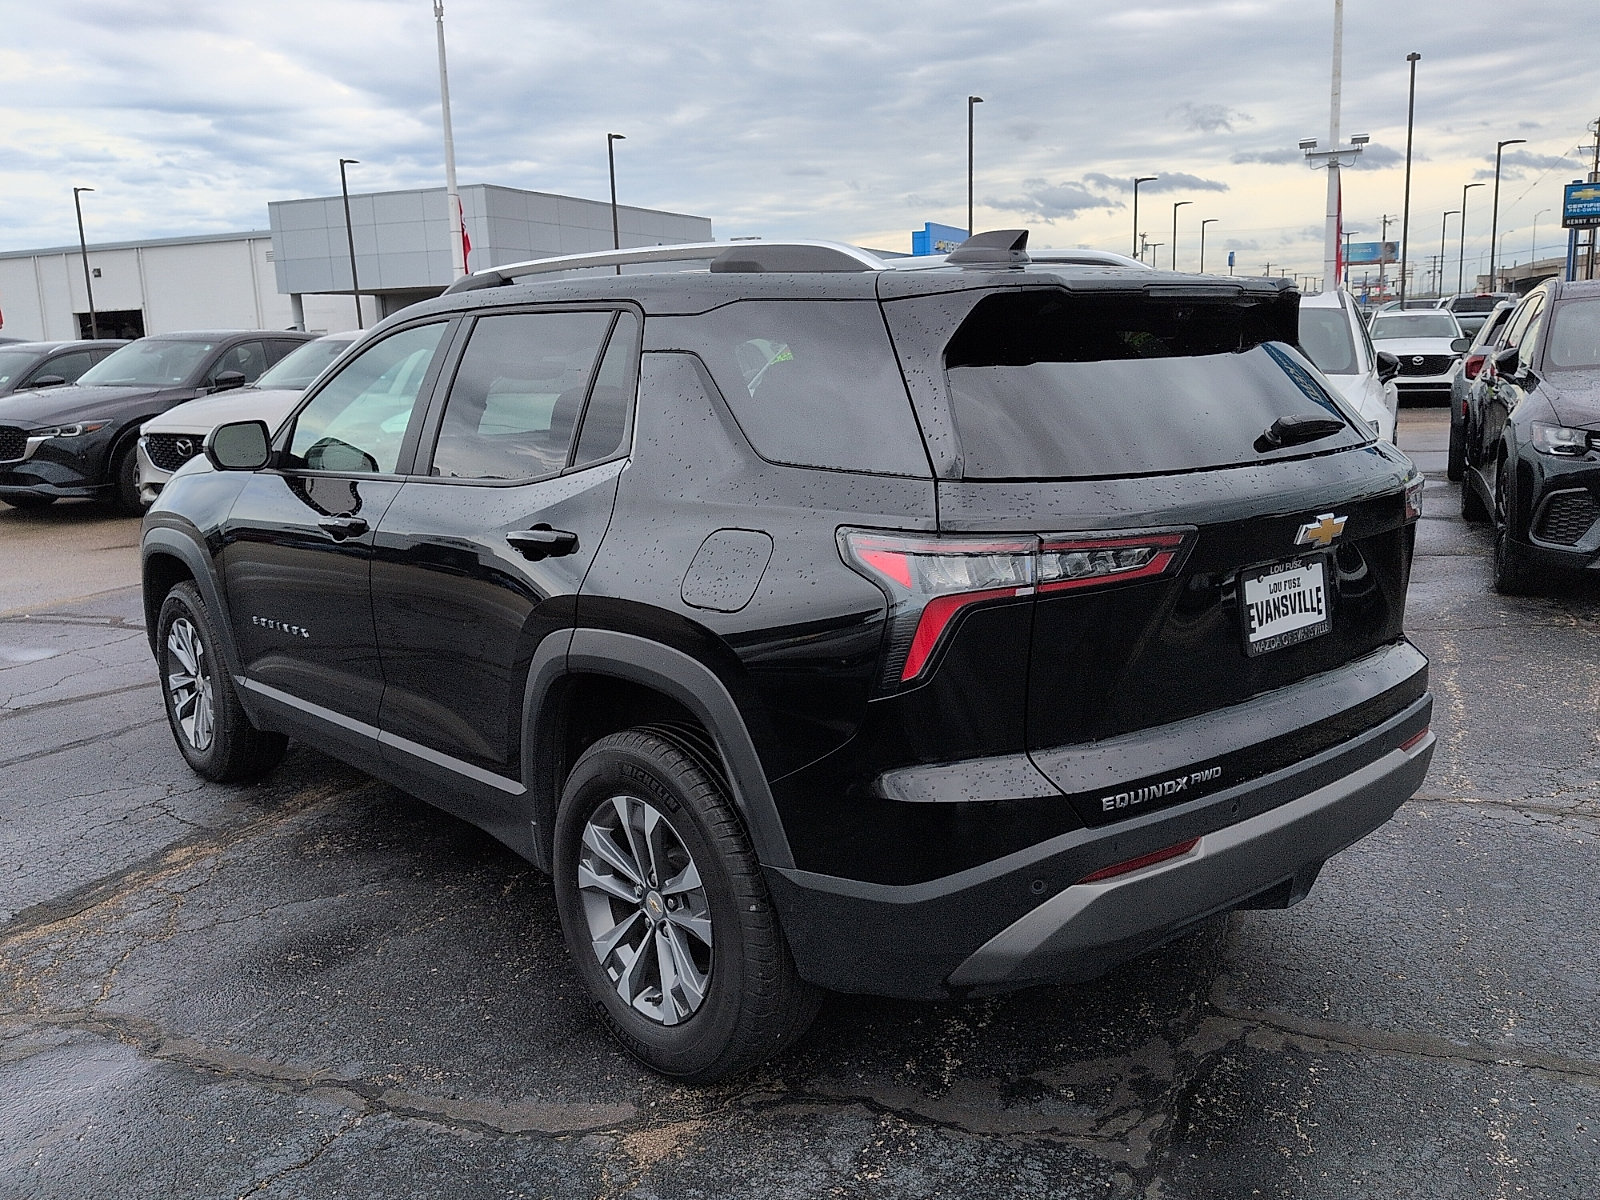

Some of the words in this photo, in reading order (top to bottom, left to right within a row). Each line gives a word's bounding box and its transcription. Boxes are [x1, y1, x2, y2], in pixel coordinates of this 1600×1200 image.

[1270, 564, 1285, 575] LOU
[1268, 581, 1282, 594] LOU
[1283, 577, 1301, 591] FUSZ
[1247, 585, 1323, 634] EVANSVILLE
[252, 615, 310, 638] EQUINOX
[1252, 637, 1281, 654] MAZDA
[1293, 621, 1329, 643] EVANSVILLE
[1101, 776, 1188, 812] EQUINOX
[1190, 766, 1222, 785] AWD
